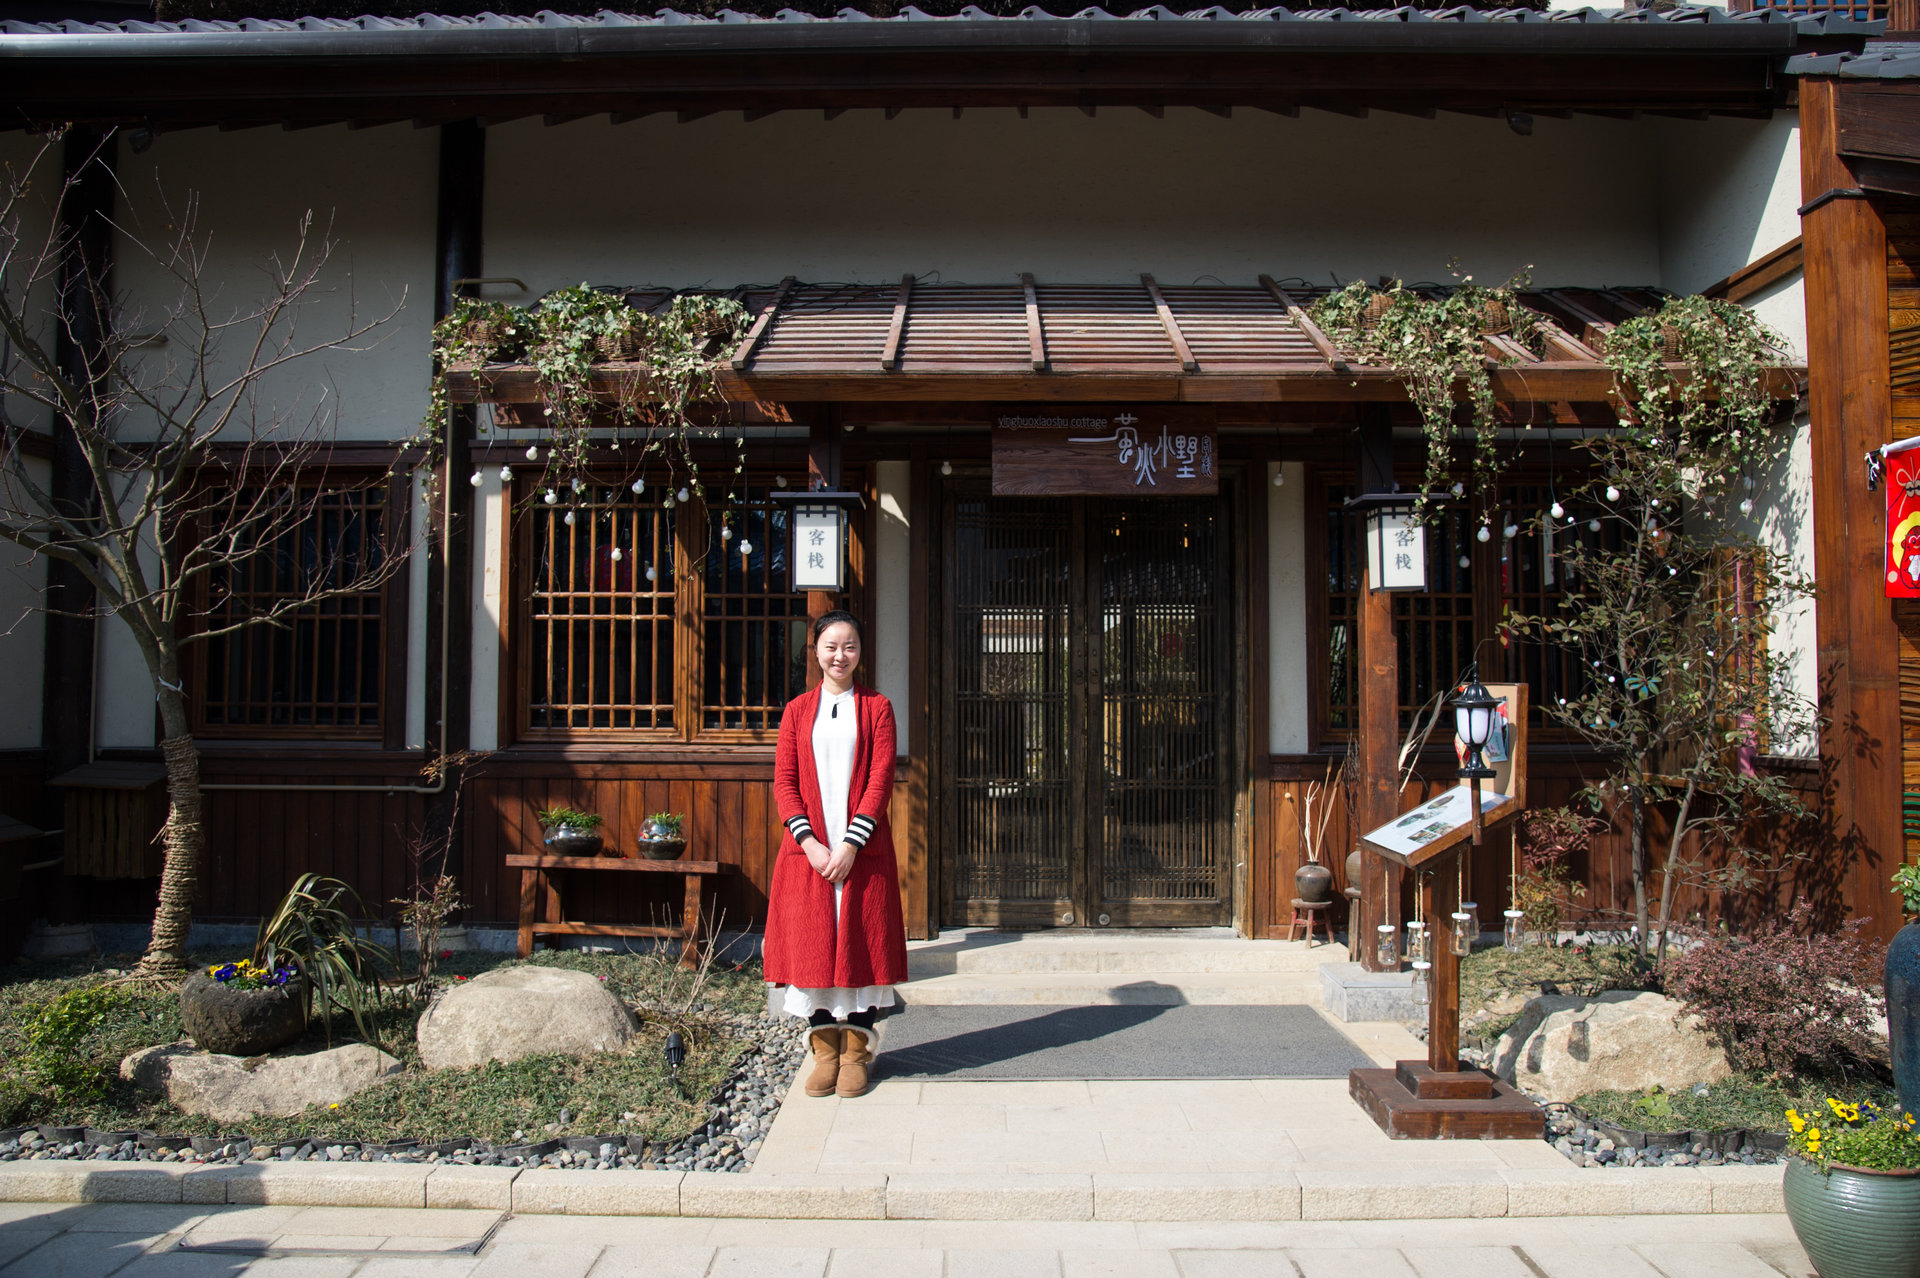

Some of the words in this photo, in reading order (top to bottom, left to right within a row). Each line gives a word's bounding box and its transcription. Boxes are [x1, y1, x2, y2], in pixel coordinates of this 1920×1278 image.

[998, 415, 1069, 428] yinghuoxiaoshu
[1071, 416, 1108, 428] cottage
[808, 529, 825, 569] 客栈
[1394, 530, 1412, 570] 客栈
